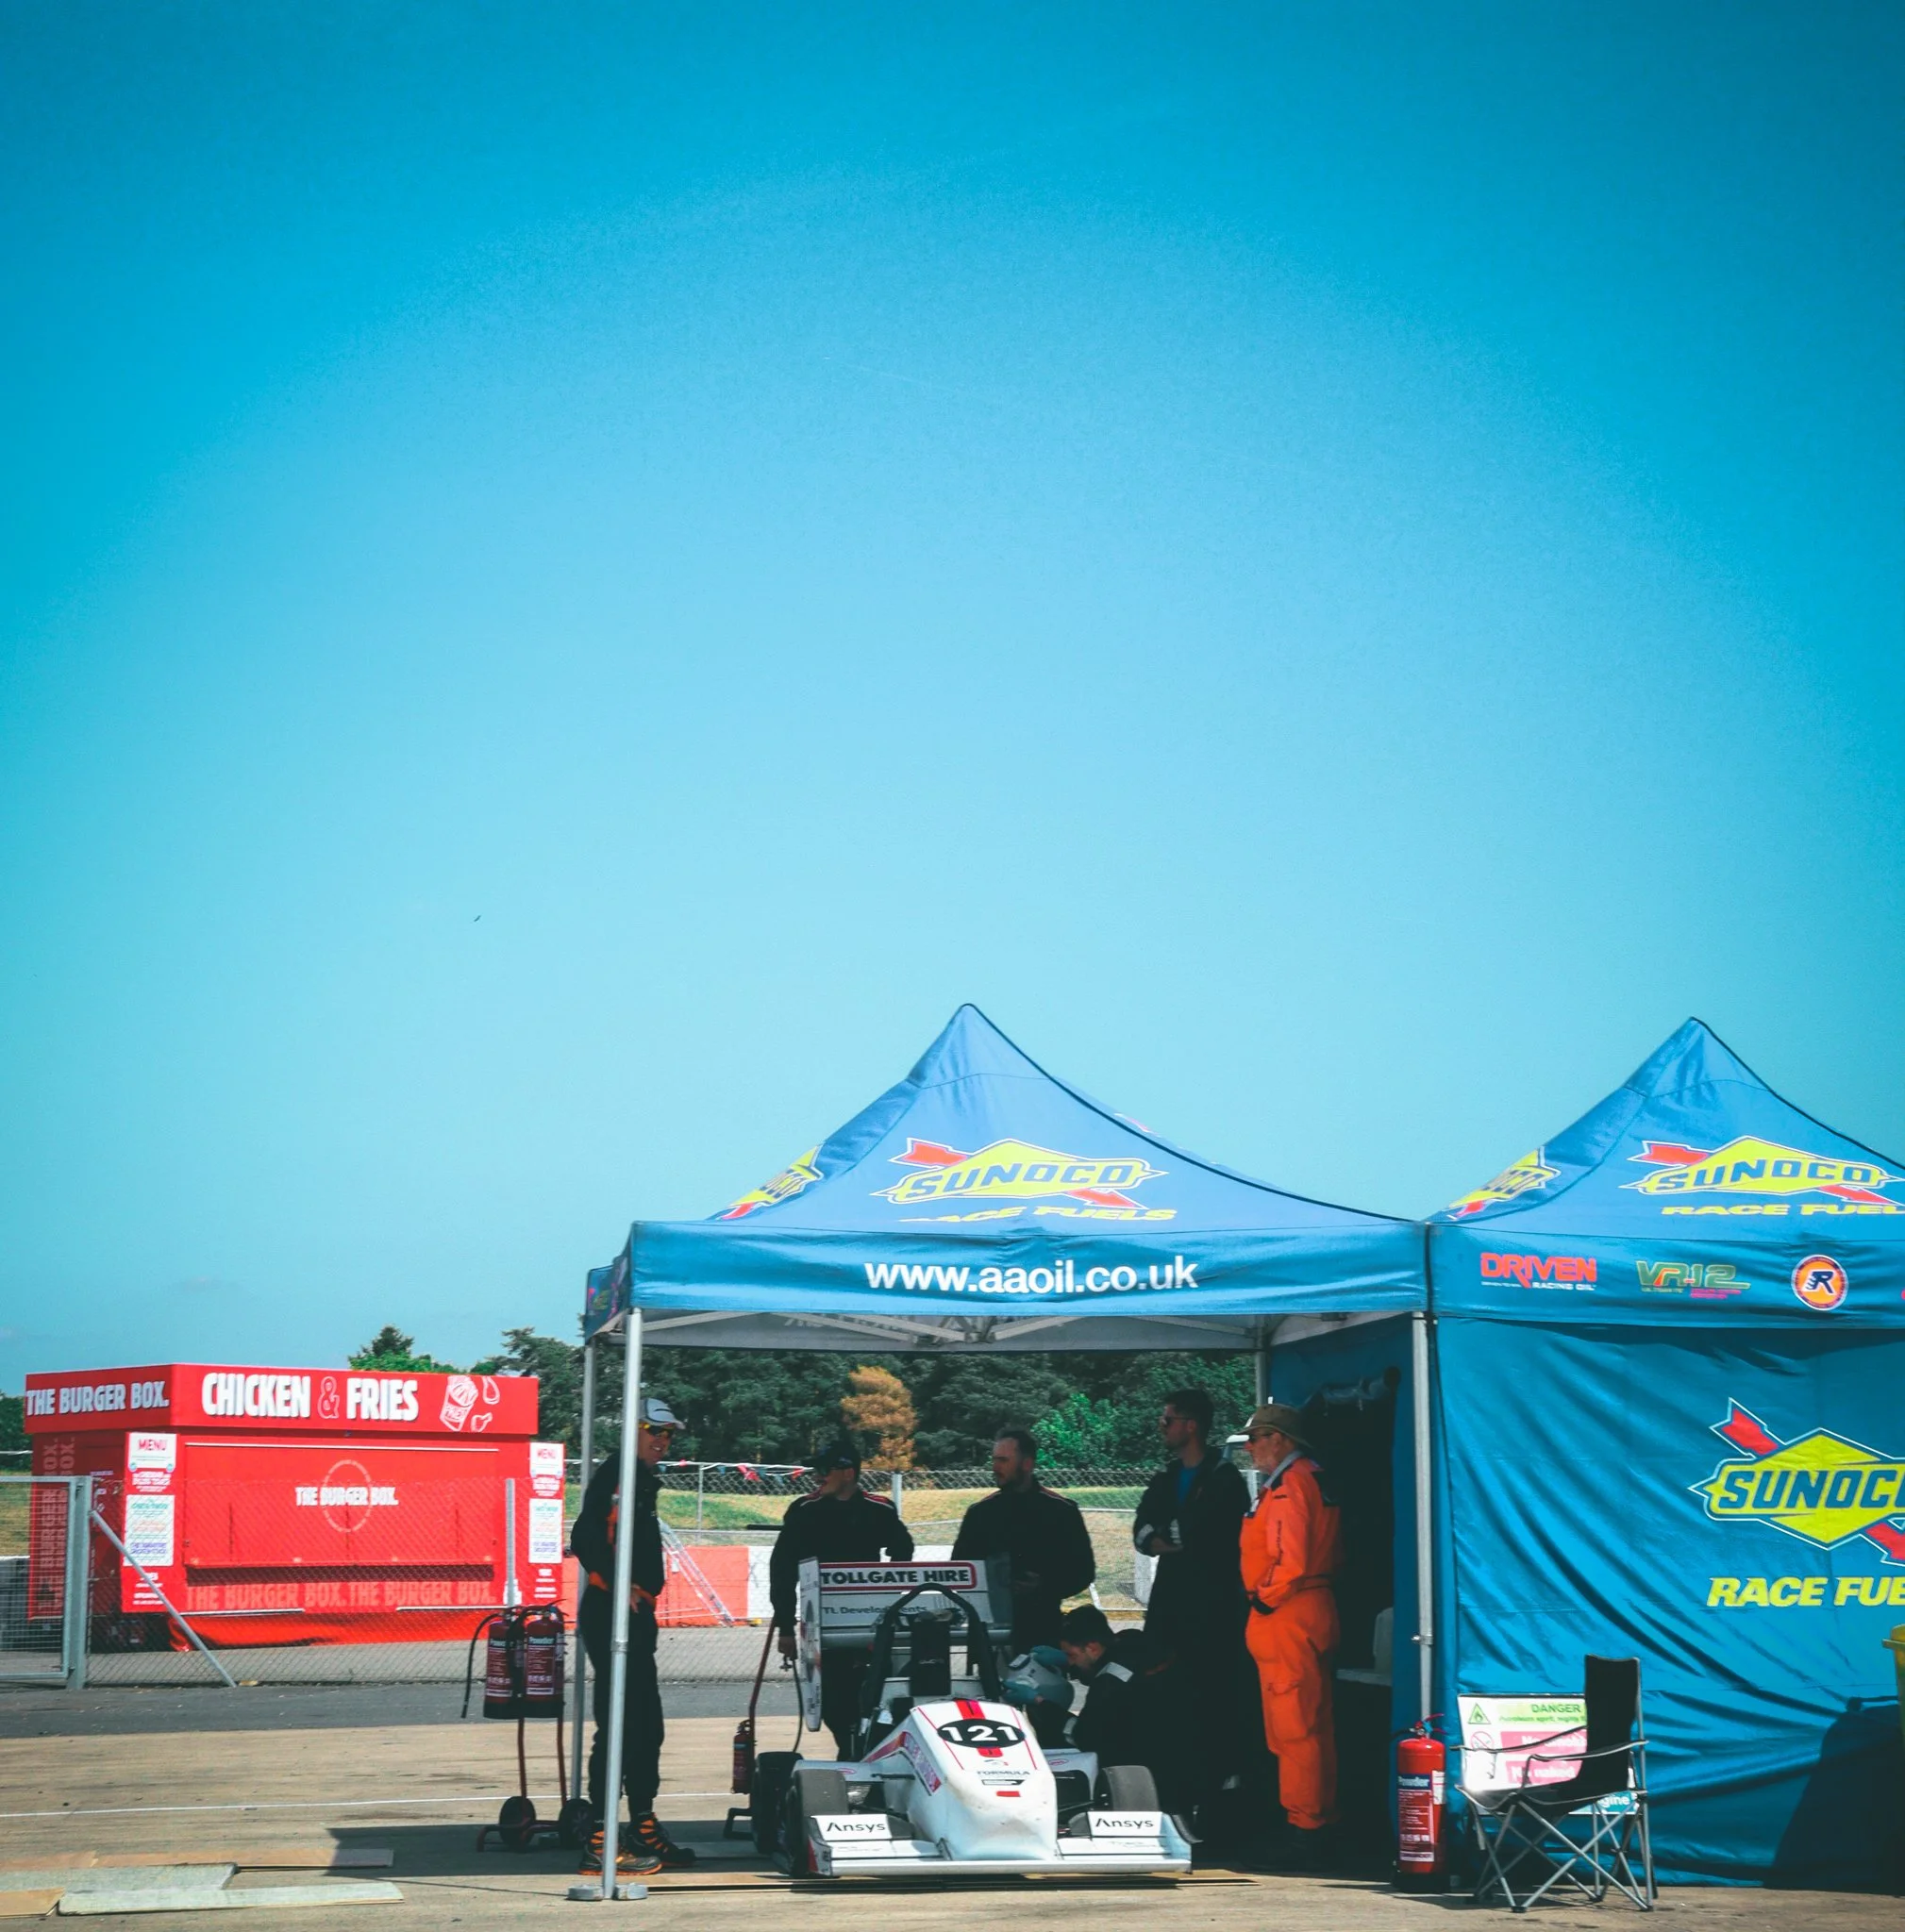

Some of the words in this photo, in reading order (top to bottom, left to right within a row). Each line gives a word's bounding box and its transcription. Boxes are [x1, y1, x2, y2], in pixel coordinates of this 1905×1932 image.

[909, 1162, 1135, 1197] SUNOCO
[1657, 1159, 1873, 1190] SUNOCO
[1033, 1206, 1178, 1221] FUELS
[1662, 1204, 1790, 1215] RACE
[864, 1256, 1198, 1293] www.aaoil.co.uk
[1480, 1252, 1596, 1289] DRIVEN
[1532, 1281, 1574, 1291] RACING
[26, 1389, 56, 1415] THE
[58, 1384, 125, 1414] BURGER
[131, 1381, 170, 1409] BOX.
[201, 1373, 310, 1418] CHICKEN
[318, 1376, 340, 1419] &
[346, 1377, 419, 1421] FRIES
[138, 1439, 168, 1451] MENU
[295, 1487, 318, 1506] THE
[320, 1487, 369, 1506] BURGER
[1717, 1469, 1905, 1509] SUNOC
[820, 1569, 918, 1584] TOLLGATE
[923, 1568, 970, 1583] HIRE
[188, 1586, 219, 1609] THE
[225, 1584, 297, 1608] BURGER
[349, 1582, 379, 1606] THE
[384, 1582, 453, 1607] BURGER
[1706, 1576, 1829, 1607] RACE
[1531, 1704, 1581, 1713] DANGER
[941, 1725, 1019, 1741] 121
[827, 1822, 886, 1833] Ansys
[1095, 1818, 1154, 1829] Ansys
